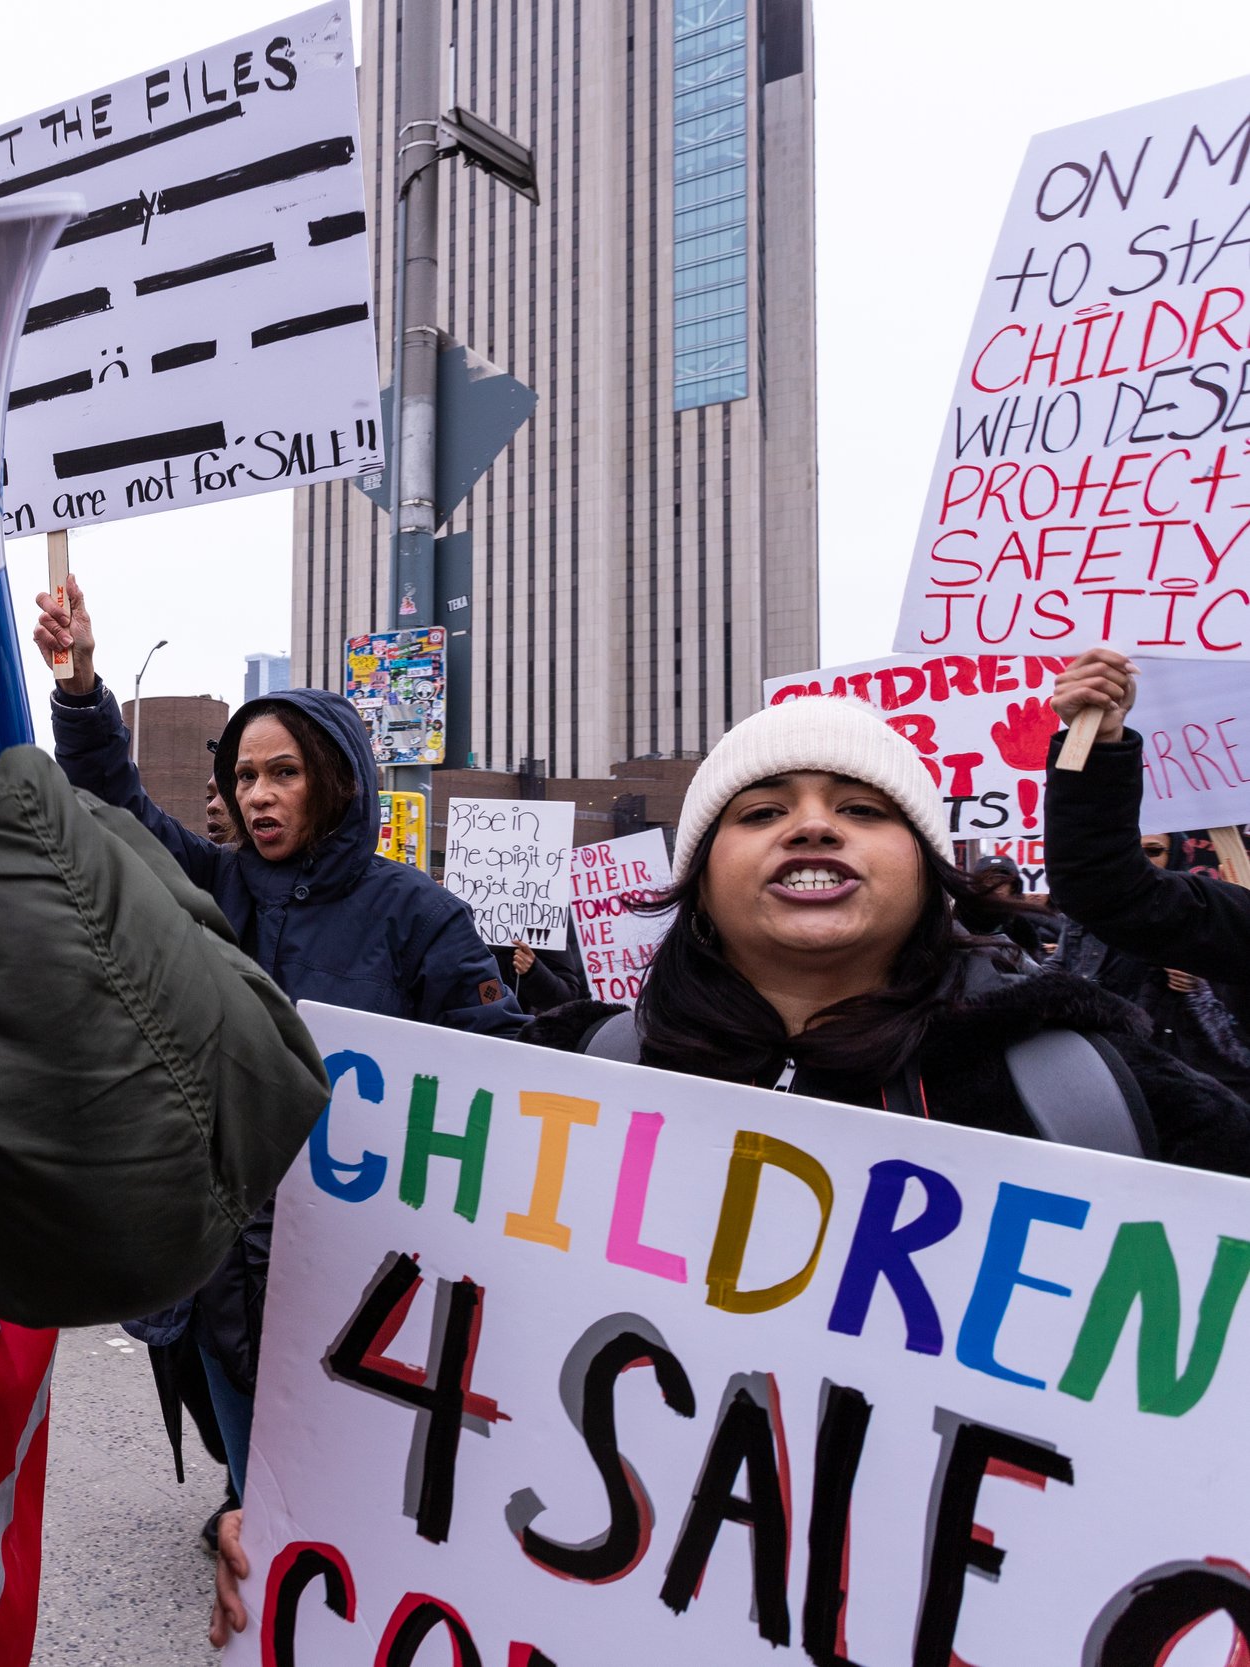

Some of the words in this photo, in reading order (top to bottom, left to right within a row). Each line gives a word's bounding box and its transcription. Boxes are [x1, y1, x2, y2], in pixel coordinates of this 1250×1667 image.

[39, 93, 113, 149] THE
[144, 37, 297, 123] FILES
[1036, 136, 1153, 222] ON
[955, 391, 1081, 459] WHO
[53, 489, 106, 519] are
[126, 460, 180, 508] not
[190, 451, 245, 495] for
[931, 518, 1250, 586] SAFETY
[920, 578, 1250, 651] JUSTIC
[450, 804, 506, 838] Rise
[512, 806, 540, 842] in
[448, 840, 483, 868] the
[546, 848, 567, 877] of
[571, 844, 615, 872] FOR
[571, 861, 652, 896] THEIR
[512, 880, 550, 905] and
[579, 921, 614, 947] WE
[309, 1049, 1250, 1418] CHILDREN
[321, 1251, 512, 1544] 4
[505, 1311, 1075, 1667] SALE
